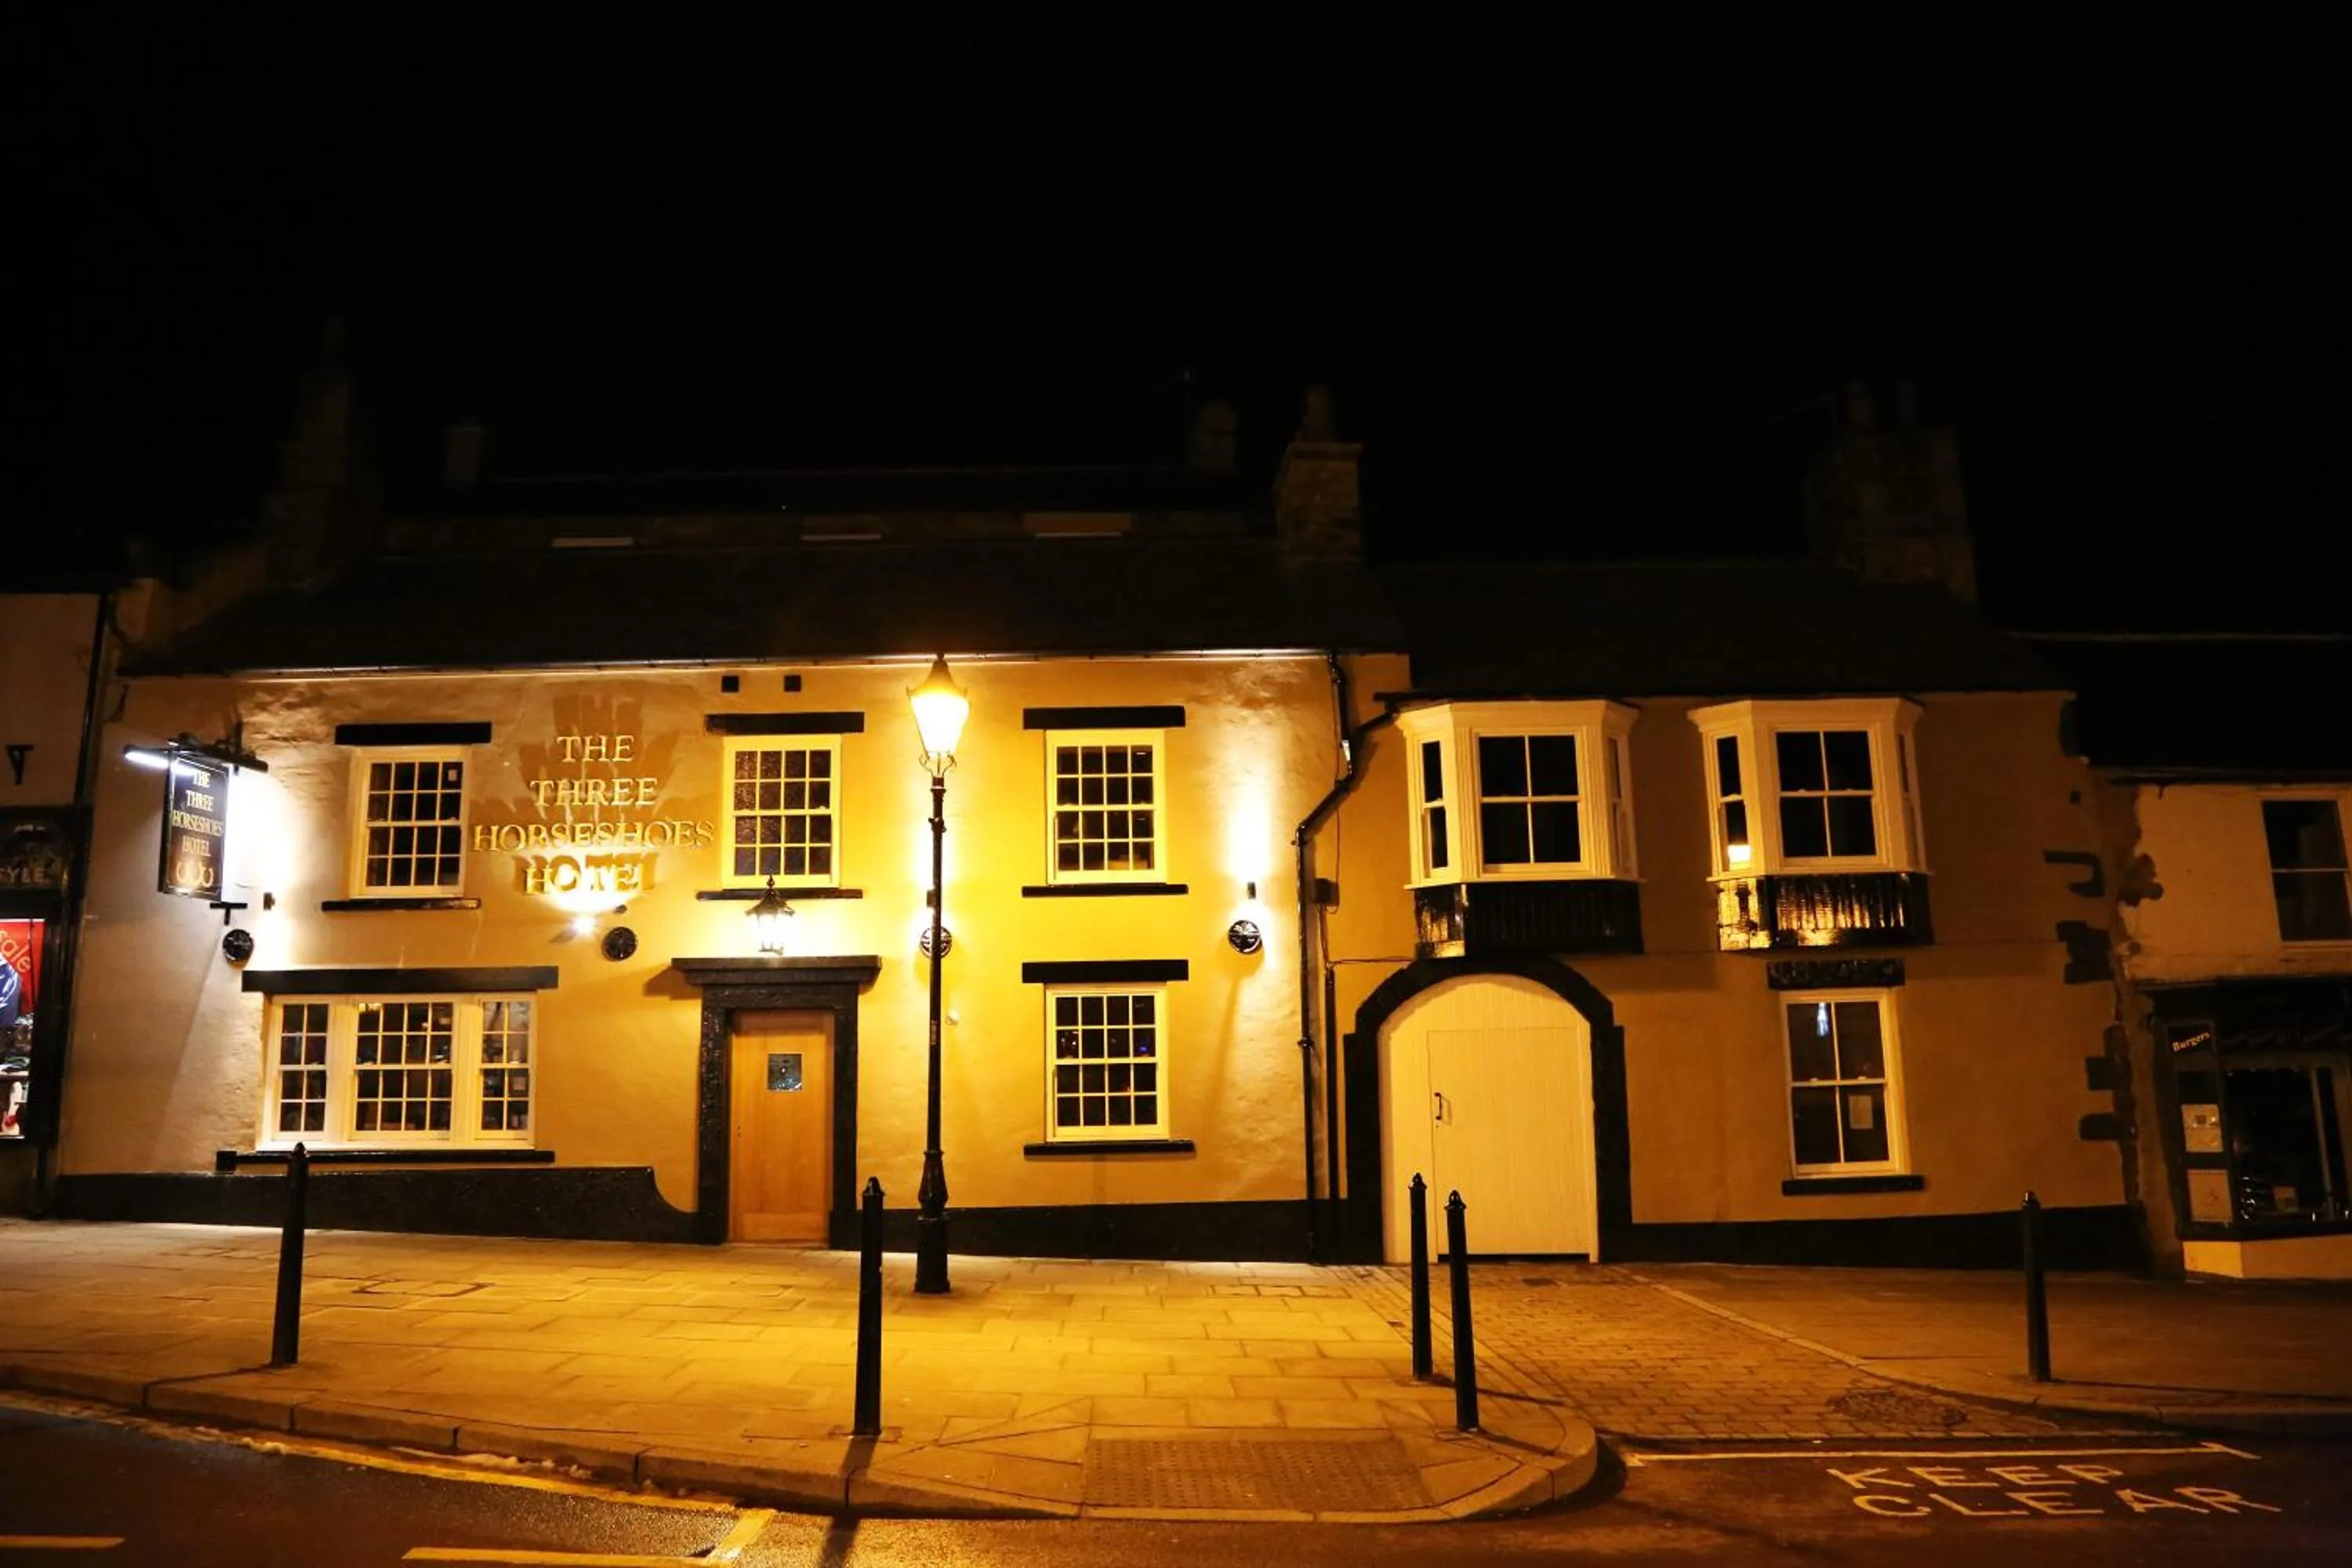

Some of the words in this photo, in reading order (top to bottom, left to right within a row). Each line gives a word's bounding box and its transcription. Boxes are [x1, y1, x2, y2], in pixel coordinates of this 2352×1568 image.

[557, 735, 634, 763] THE
[193, 770, 211, 788] THE
[530, 778, 658, 806] THREE
[186, 790, 213, 811] THREE
[172, 810, 223, 837] HORSESHOES
[474, 820, 715, 851] HORSESHOES
[182, 836, 211, 856] HOTEL
[525, 865, 657, 895] HOTEL
[1826, 1465, 2123, 1489] KEEP
[1853, 1486, 2283, 1515] CLEAR
